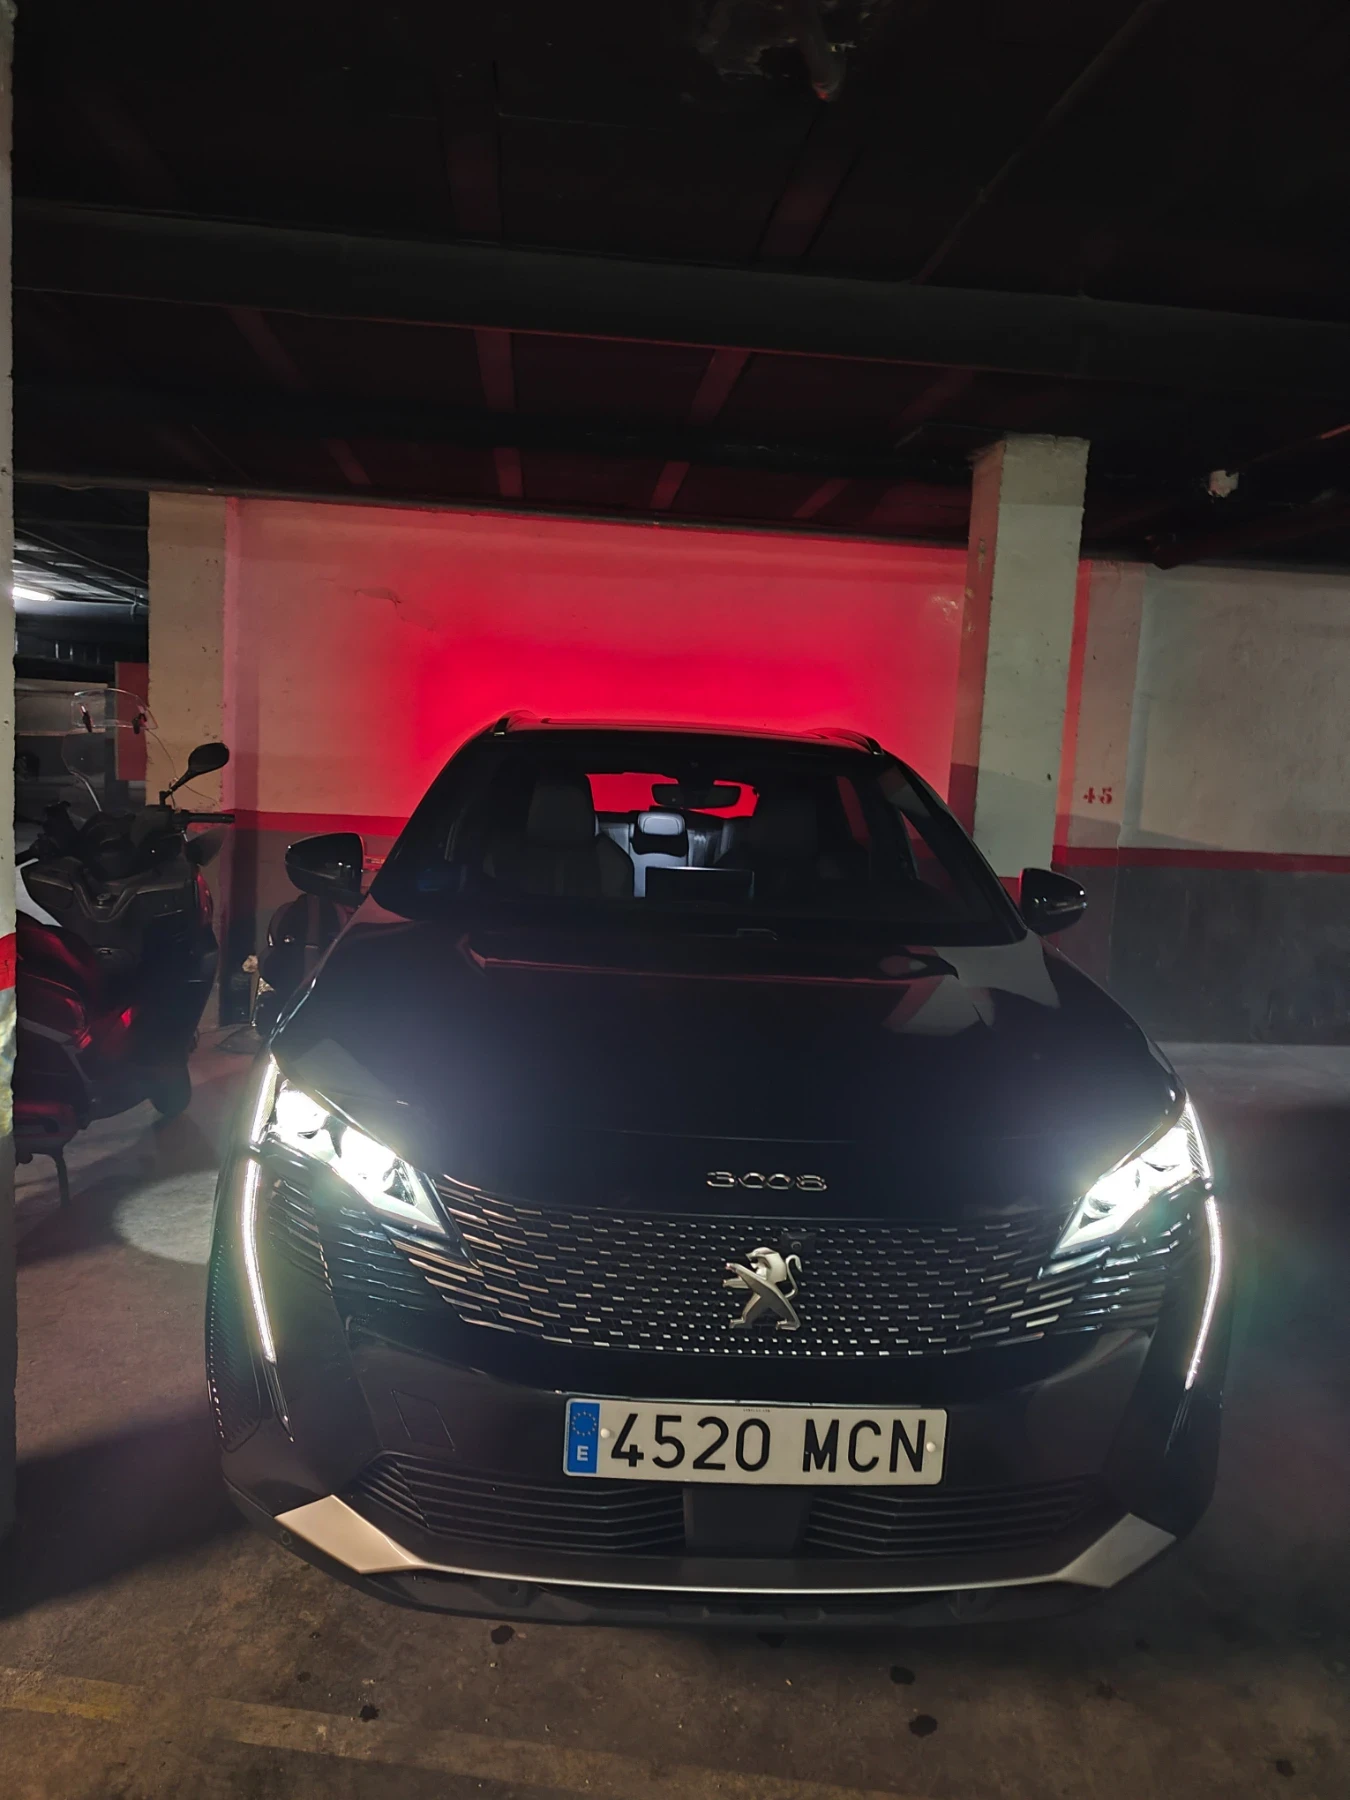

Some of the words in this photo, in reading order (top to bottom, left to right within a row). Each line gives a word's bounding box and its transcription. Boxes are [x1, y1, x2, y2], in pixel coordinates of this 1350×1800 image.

[1083, 787, 1112, 804] 45
[706, 1171, 828, 1191] 3008
[610, 1413, 771, 1472] 4520
[802, 1419, 926, 1473] MCN
[577, 1445, 589, 1462] E
